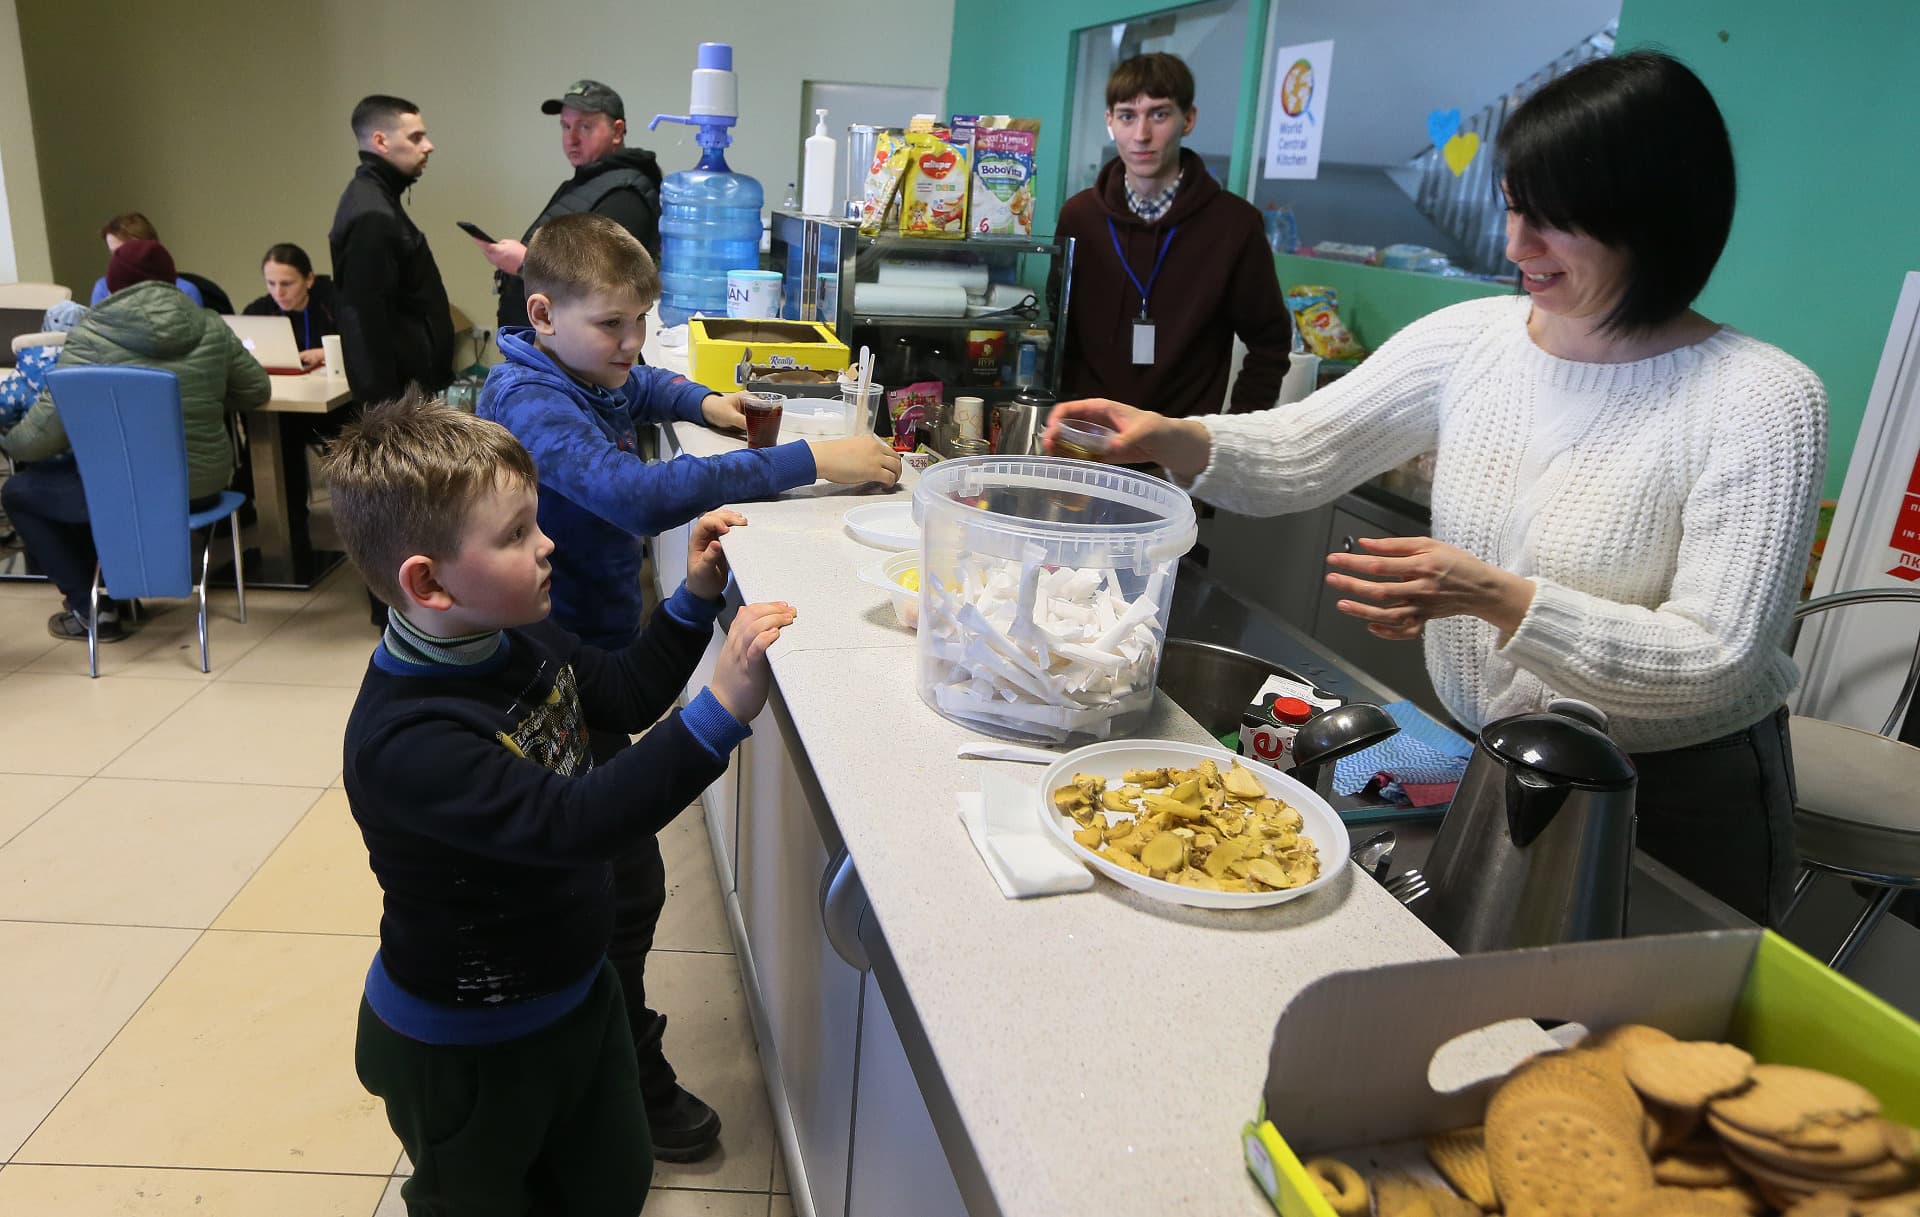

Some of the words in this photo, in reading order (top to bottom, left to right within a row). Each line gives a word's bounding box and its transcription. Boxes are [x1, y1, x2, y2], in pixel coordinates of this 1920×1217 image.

[1280, 122, 1303, 134] World
[1278, 137, 1308, 150] Central
[1276, 153, 1307, 166] Kitchen
[981, 166, 1022, 178] BoboVita
[979, 218, 989, 232] 6
[728, 287, 749, 302] AN
